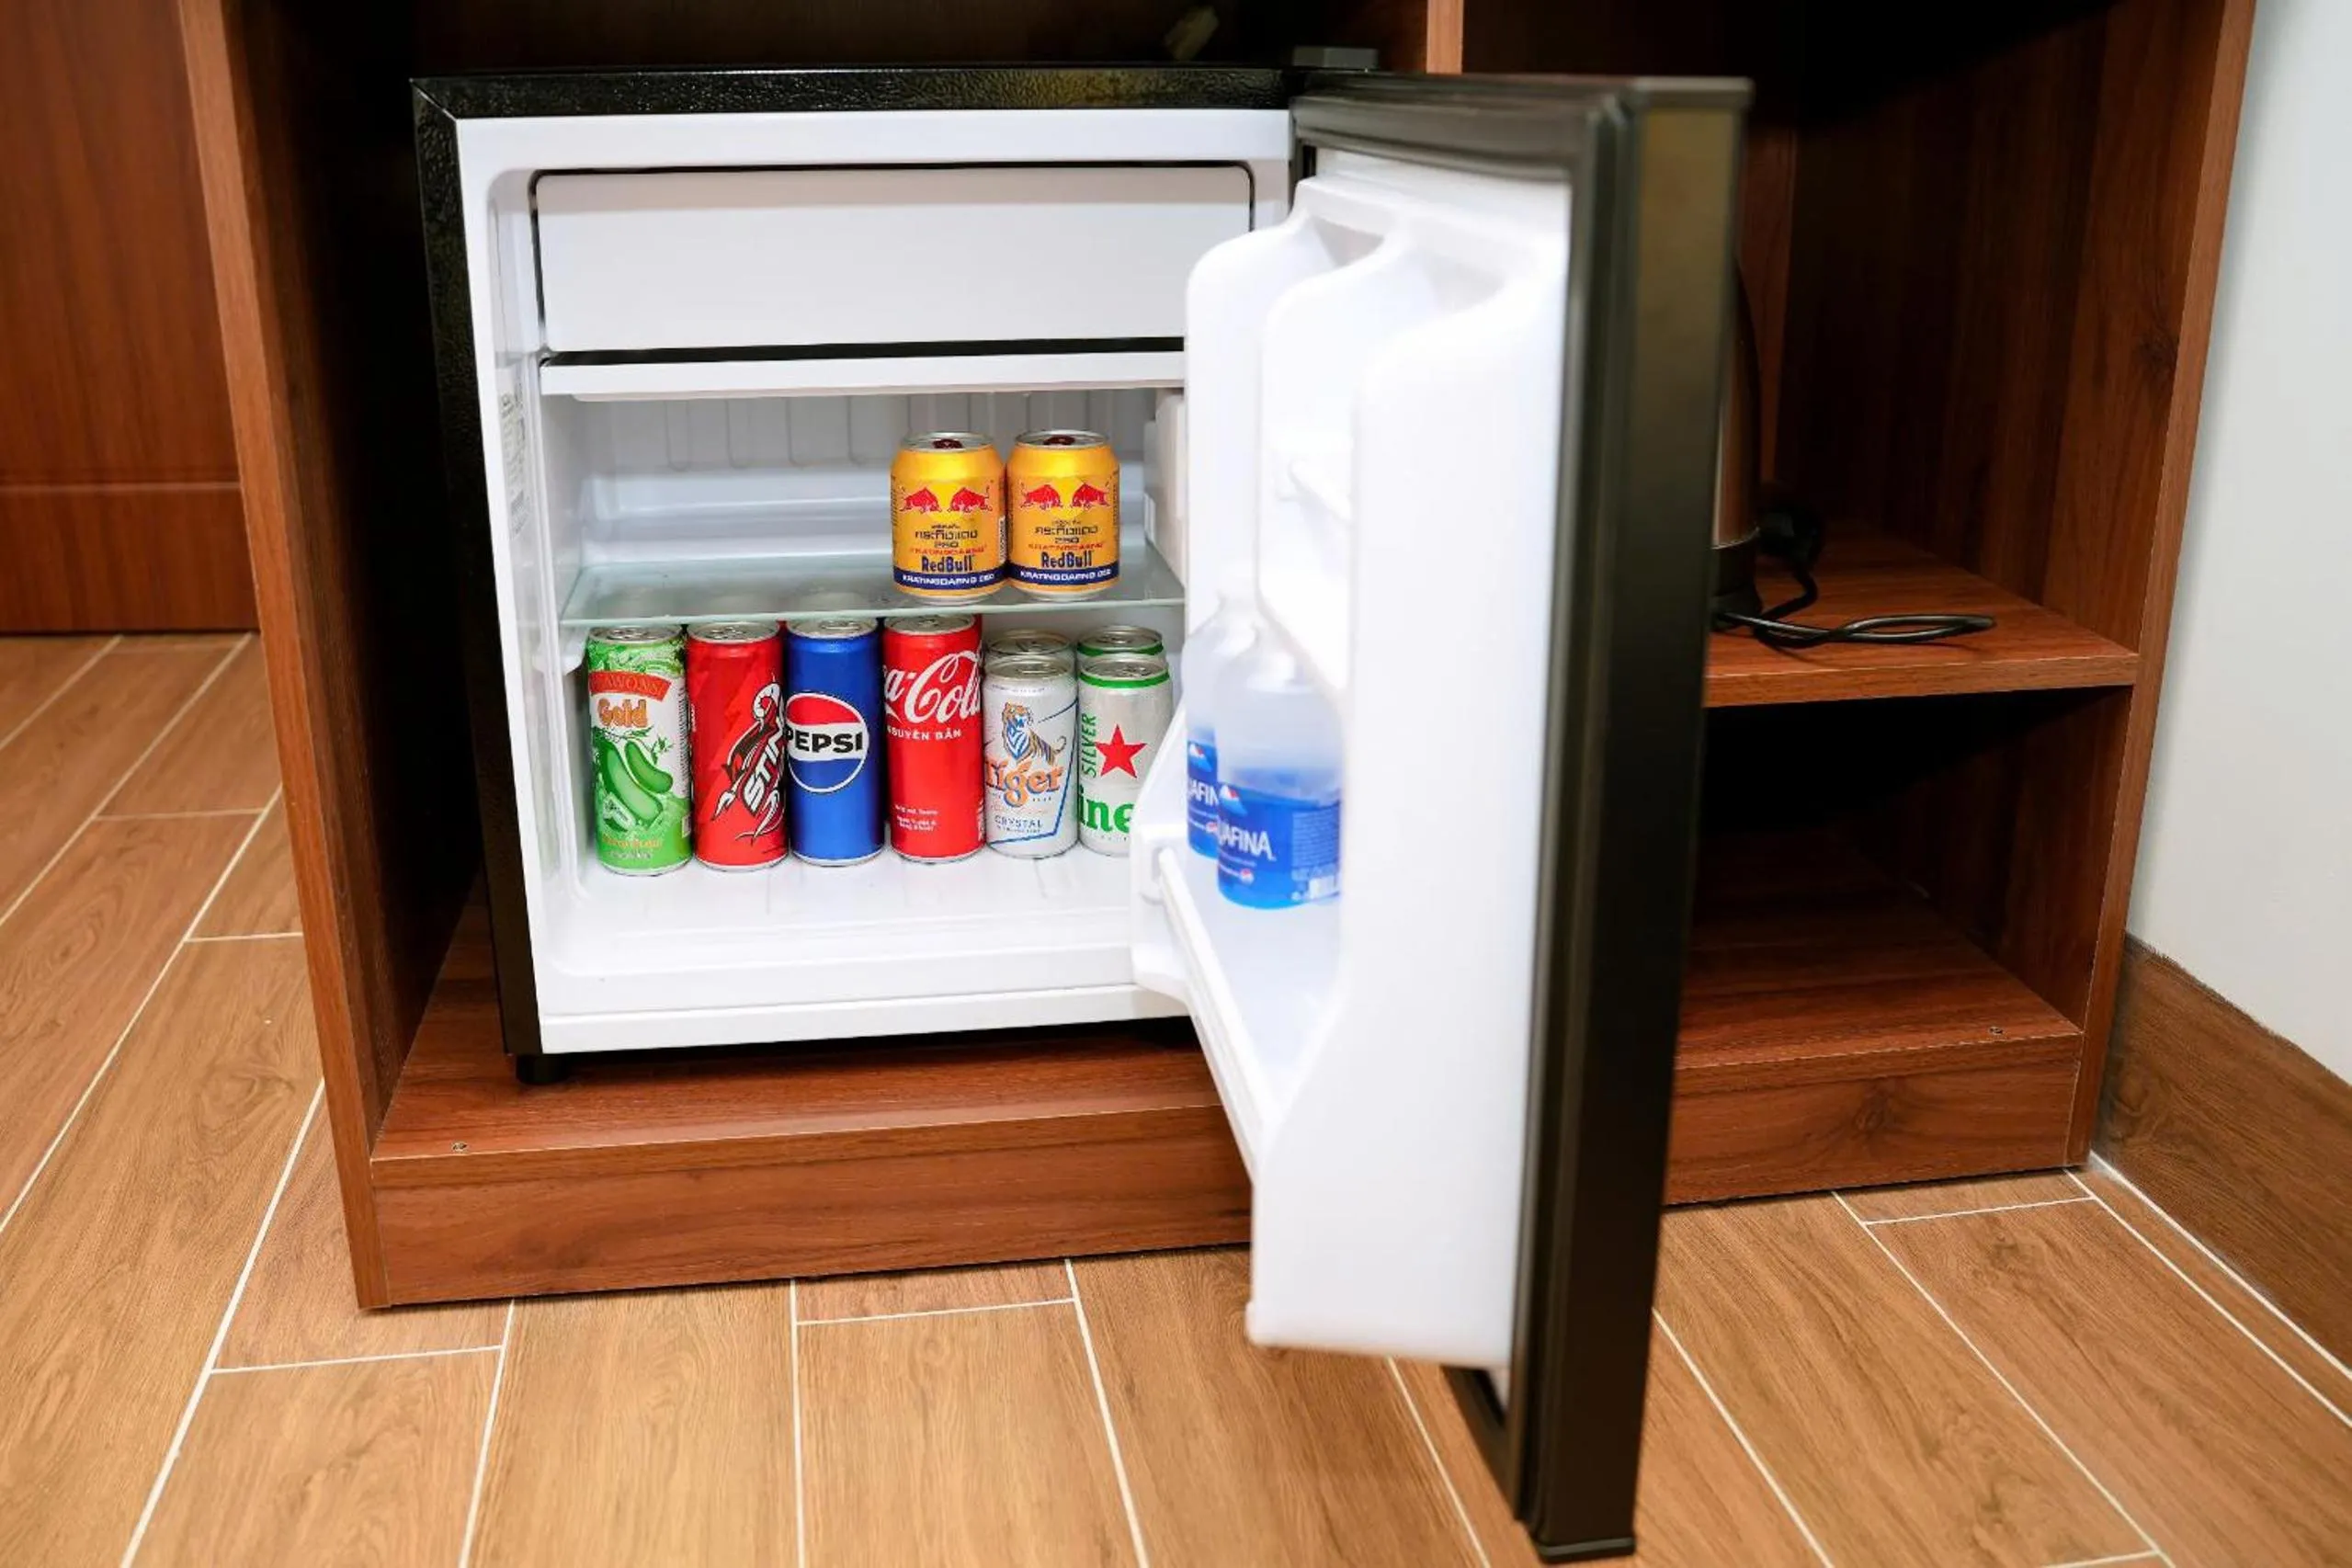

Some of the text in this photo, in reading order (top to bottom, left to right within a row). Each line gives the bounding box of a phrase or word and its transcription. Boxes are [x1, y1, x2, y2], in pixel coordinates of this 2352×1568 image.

[785, 724, 863, 753] PEPSI
[1081, 712, 1096, 778] SILVER
[1078, 784, 1135, 834] ine
